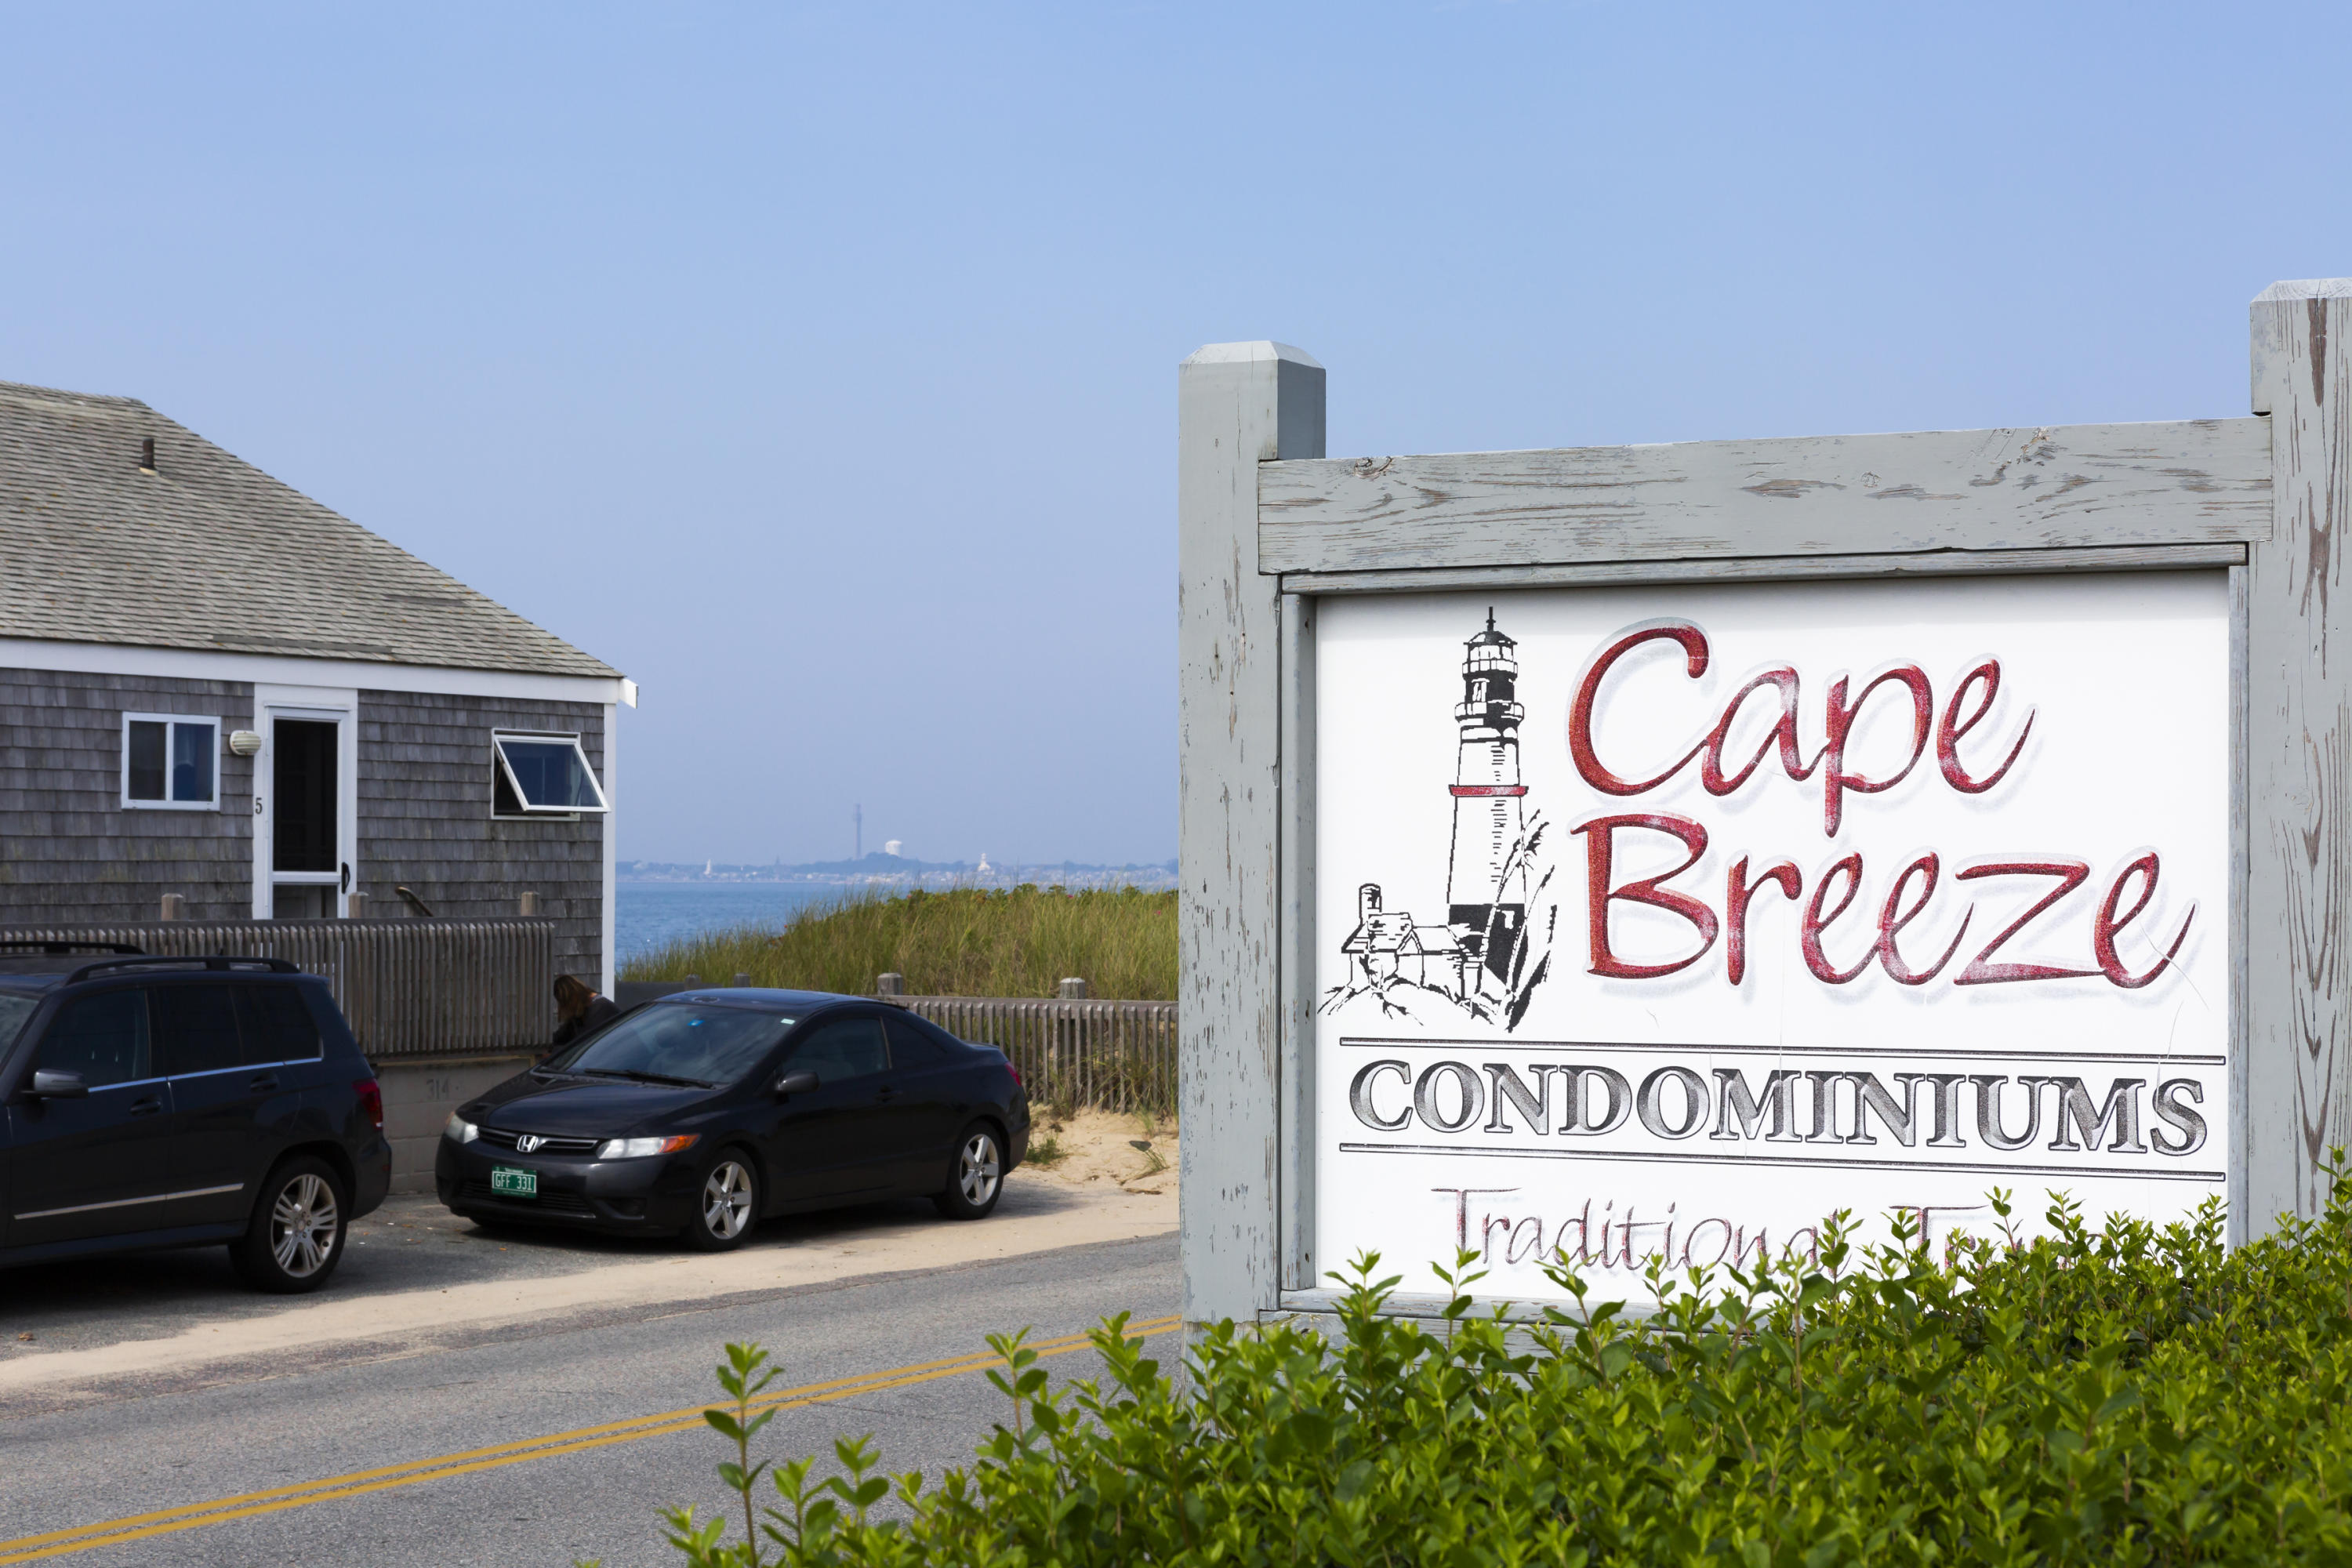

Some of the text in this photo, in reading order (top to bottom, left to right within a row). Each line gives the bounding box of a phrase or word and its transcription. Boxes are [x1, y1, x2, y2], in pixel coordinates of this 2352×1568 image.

[1569, 625, 2035, 837] Cape
[256, 797, 263, 815] 5
[1570, 813, 2196, 989] Breeze
[1349, 1059, 2207, 1156] CONDOMINIUMS
[495, 1174, 532, 1191] GFF 331
